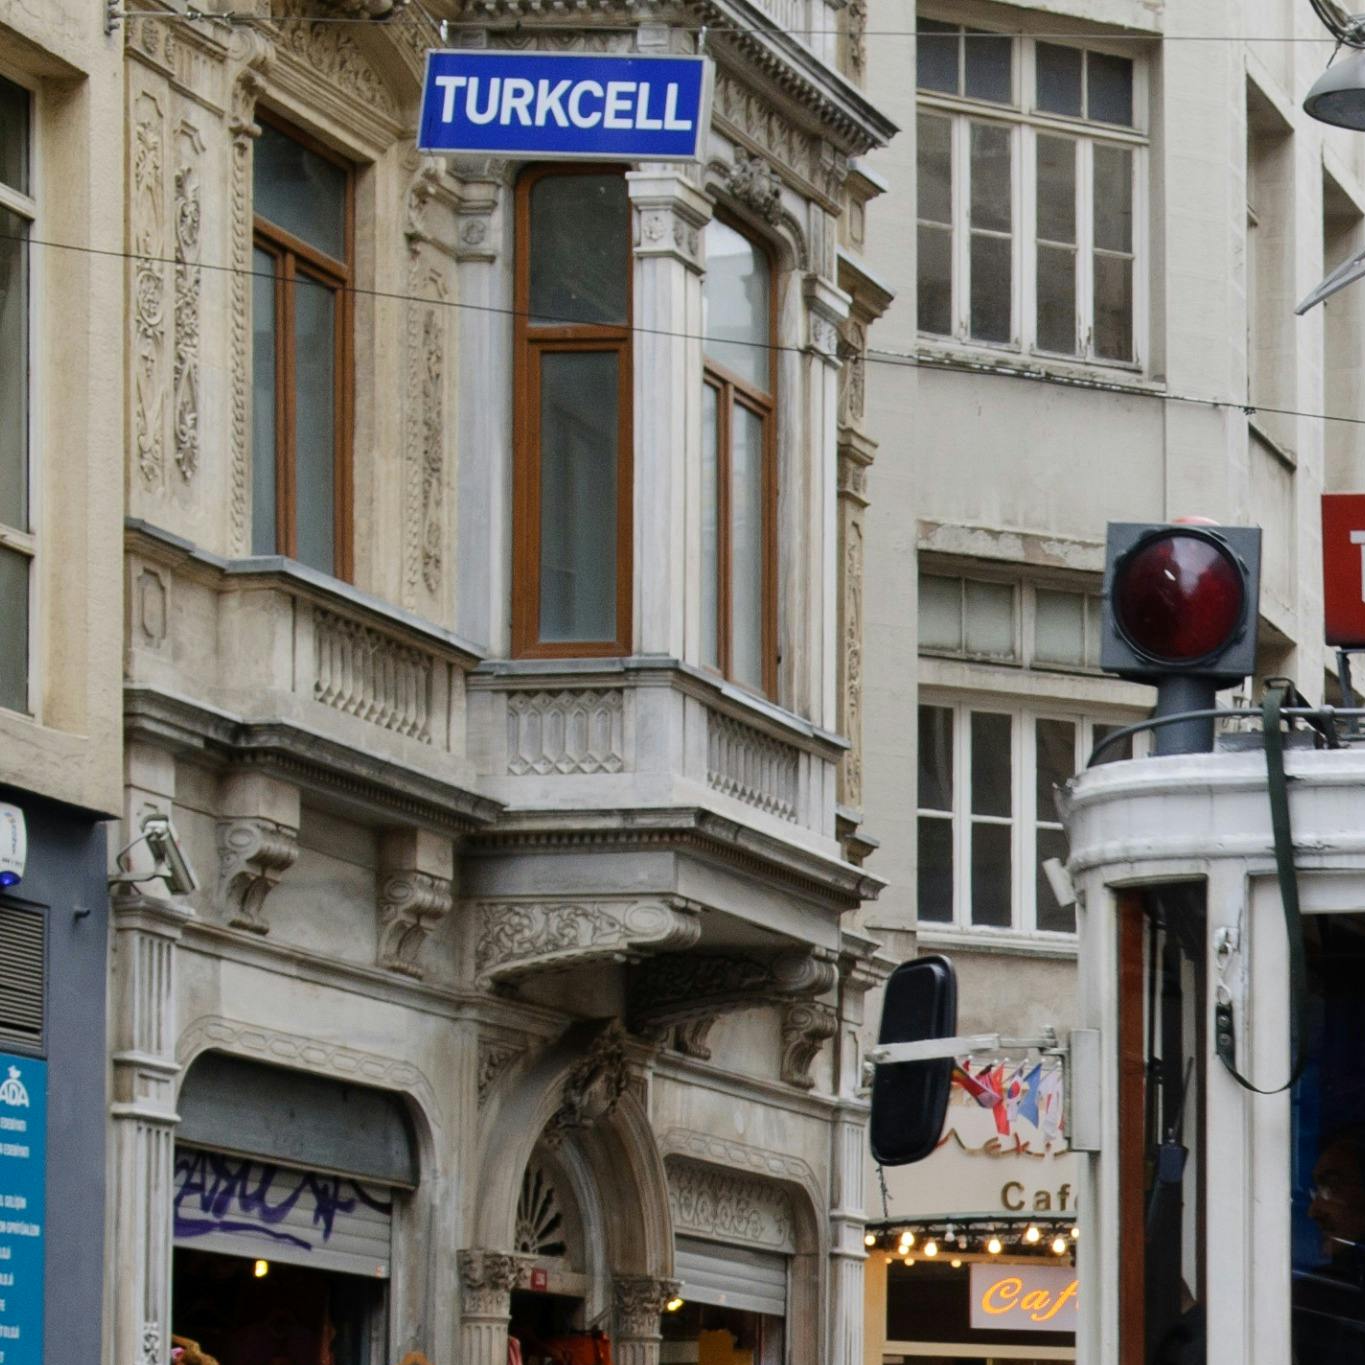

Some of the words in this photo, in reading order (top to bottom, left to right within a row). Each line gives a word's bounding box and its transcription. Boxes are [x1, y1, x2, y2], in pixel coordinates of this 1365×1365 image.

[435, 75, 692, 130] TURKCELL
[1001, 1181, 1077, 1211] Caf
[981, 1277, 1079, 1321] Caf
